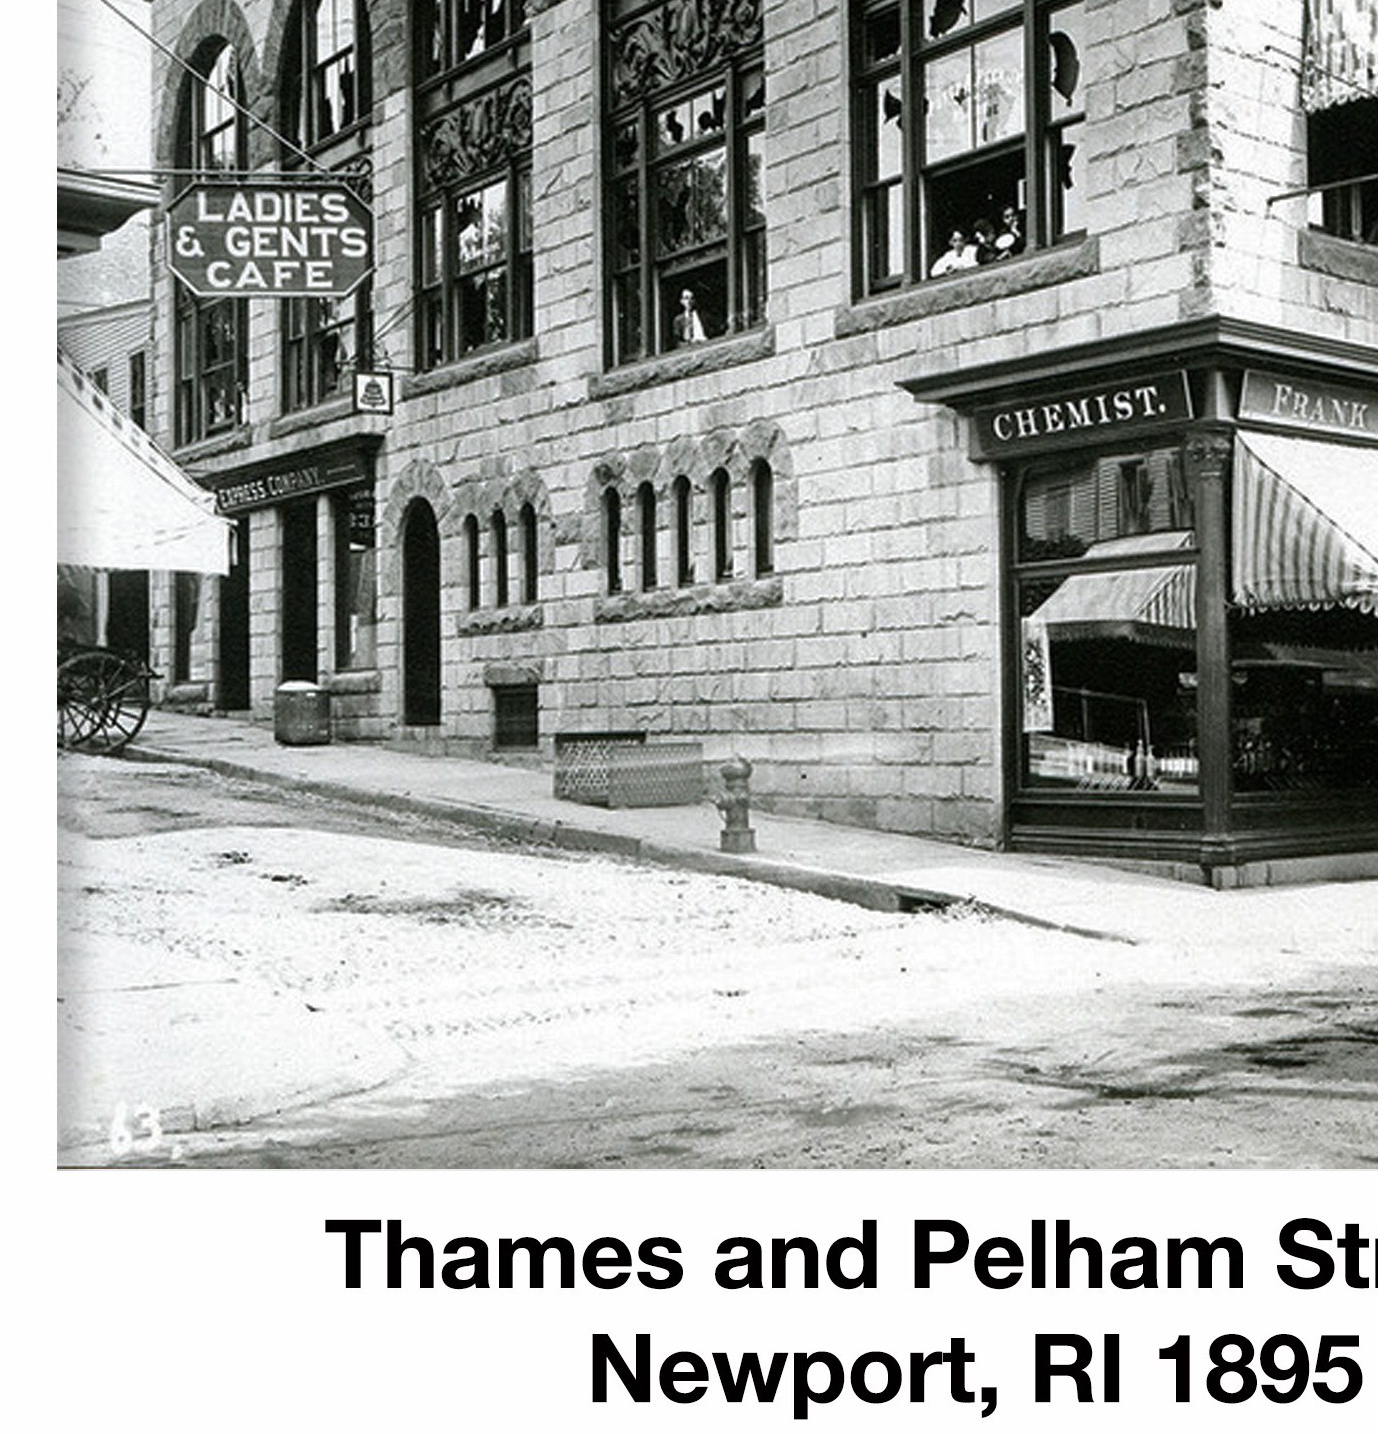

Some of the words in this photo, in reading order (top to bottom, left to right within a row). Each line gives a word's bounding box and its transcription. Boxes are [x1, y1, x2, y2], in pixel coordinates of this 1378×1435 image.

[197, 191, 350, 224] LADIES
[176, 225, 205, 257] &
[225, 225, 368, 257] GENTS
[206, 261, 334, 288] CAFE
[993, 386, 1166, 440] CHEMIST.
